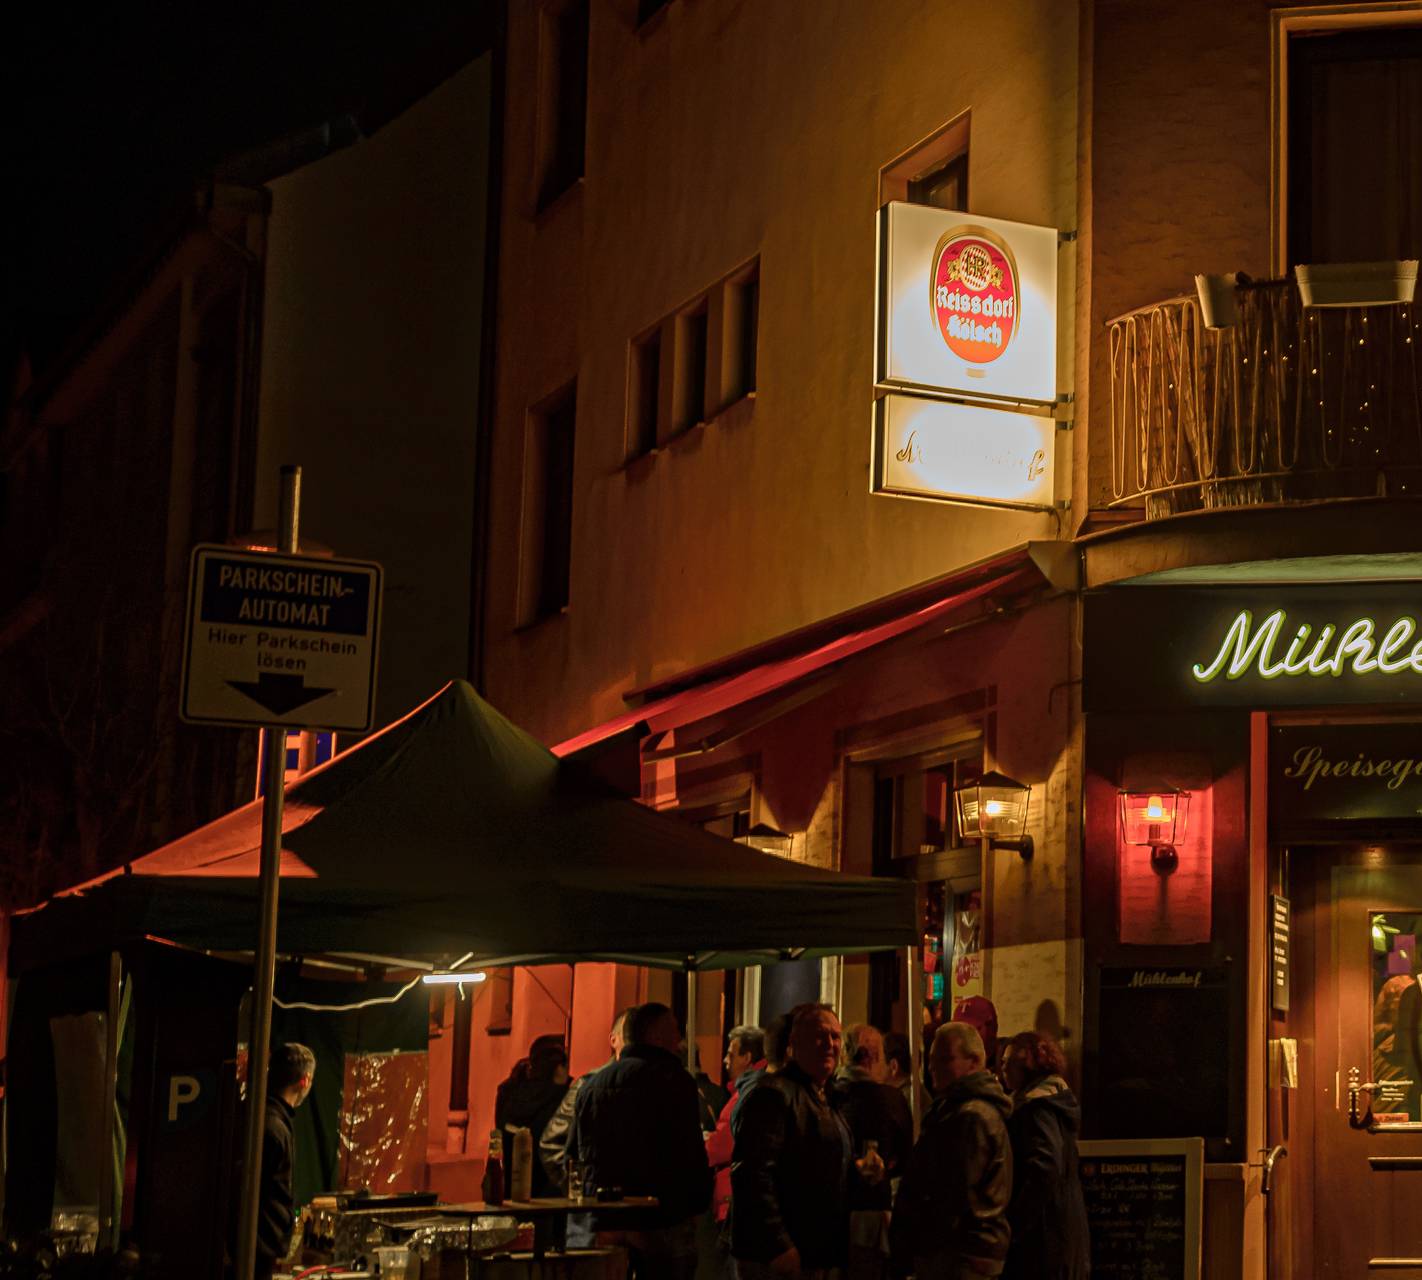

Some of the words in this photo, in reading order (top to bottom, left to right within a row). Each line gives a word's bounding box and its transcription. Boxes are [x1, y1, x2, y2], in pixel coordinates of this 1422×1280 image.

[936, 284, 1014, 318] Reissdorf
[219, 564, 355, 599] PARKSCHEIN-
[239, 597, 331, 626] AUTOMAT
[208, 628, 247, 646] Hier
[256, 631, 357, 656] Parkschein
[257, 652, 307, 671] lösen
[168, 1075, 201, 1122] P
